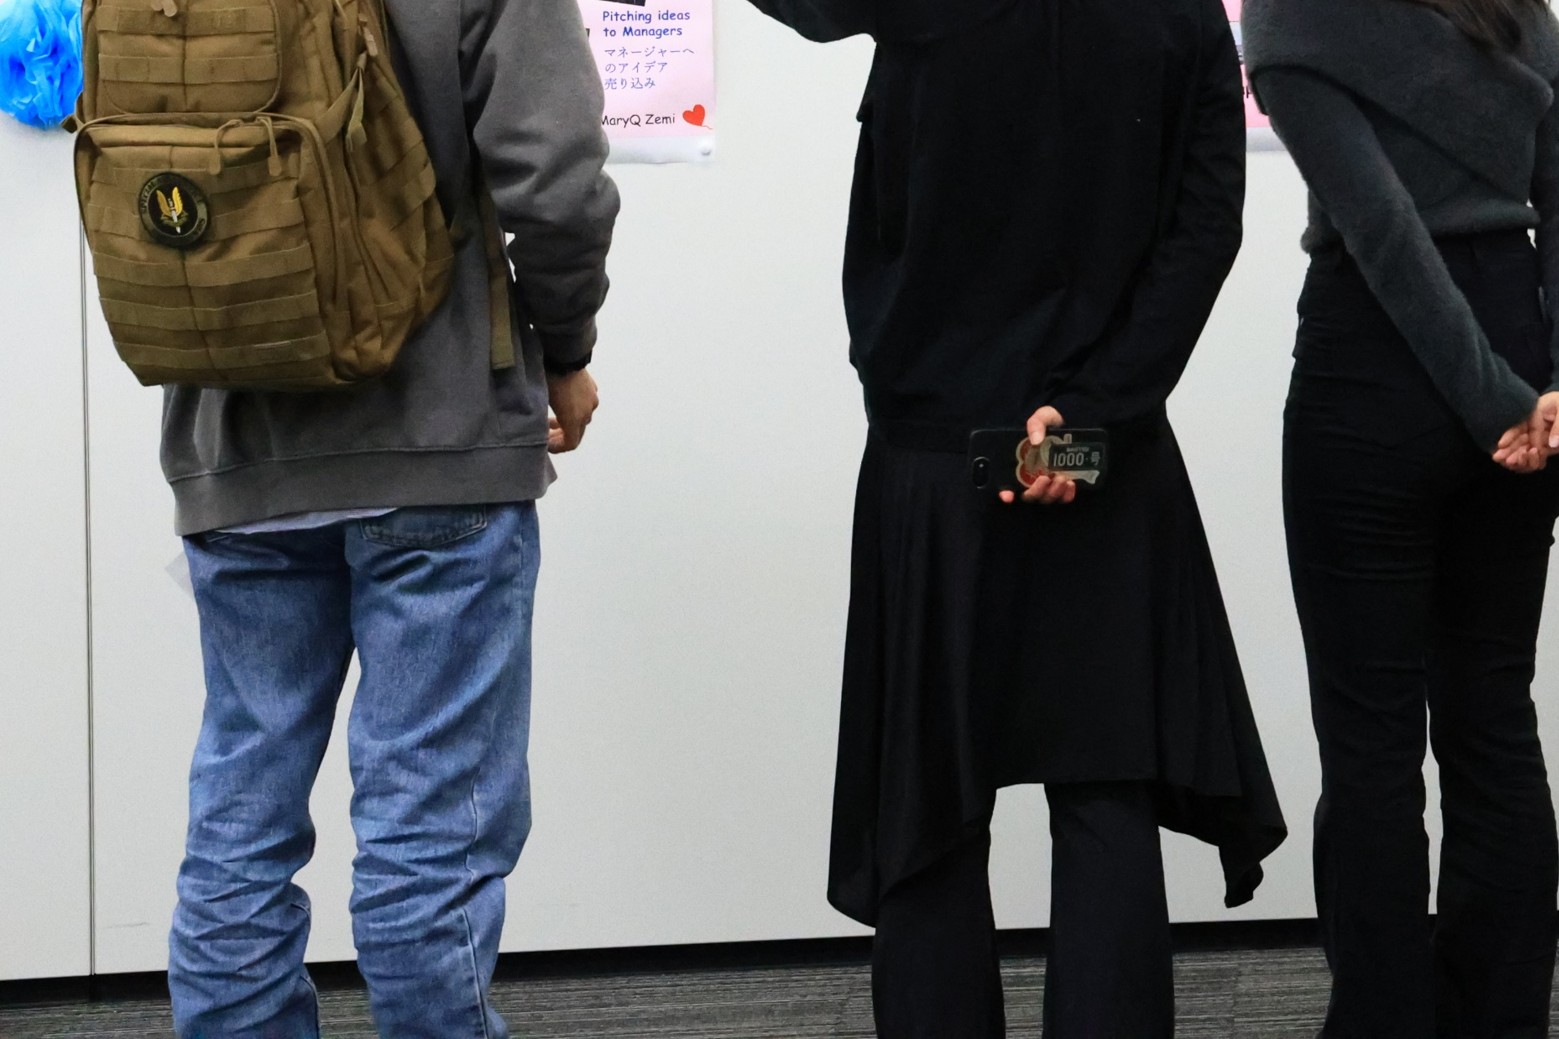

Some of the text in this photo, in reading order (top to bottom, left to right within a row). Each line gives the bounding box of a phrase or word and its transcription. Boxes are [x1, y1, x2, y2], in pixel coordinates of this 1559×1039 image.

[602, 10, 691, 24] Pitching ideas
[603, 26, 683, 40] to Managers
[605, 61, 668, 73] のアイデア
[645, 113, 676, 125] Zemi
